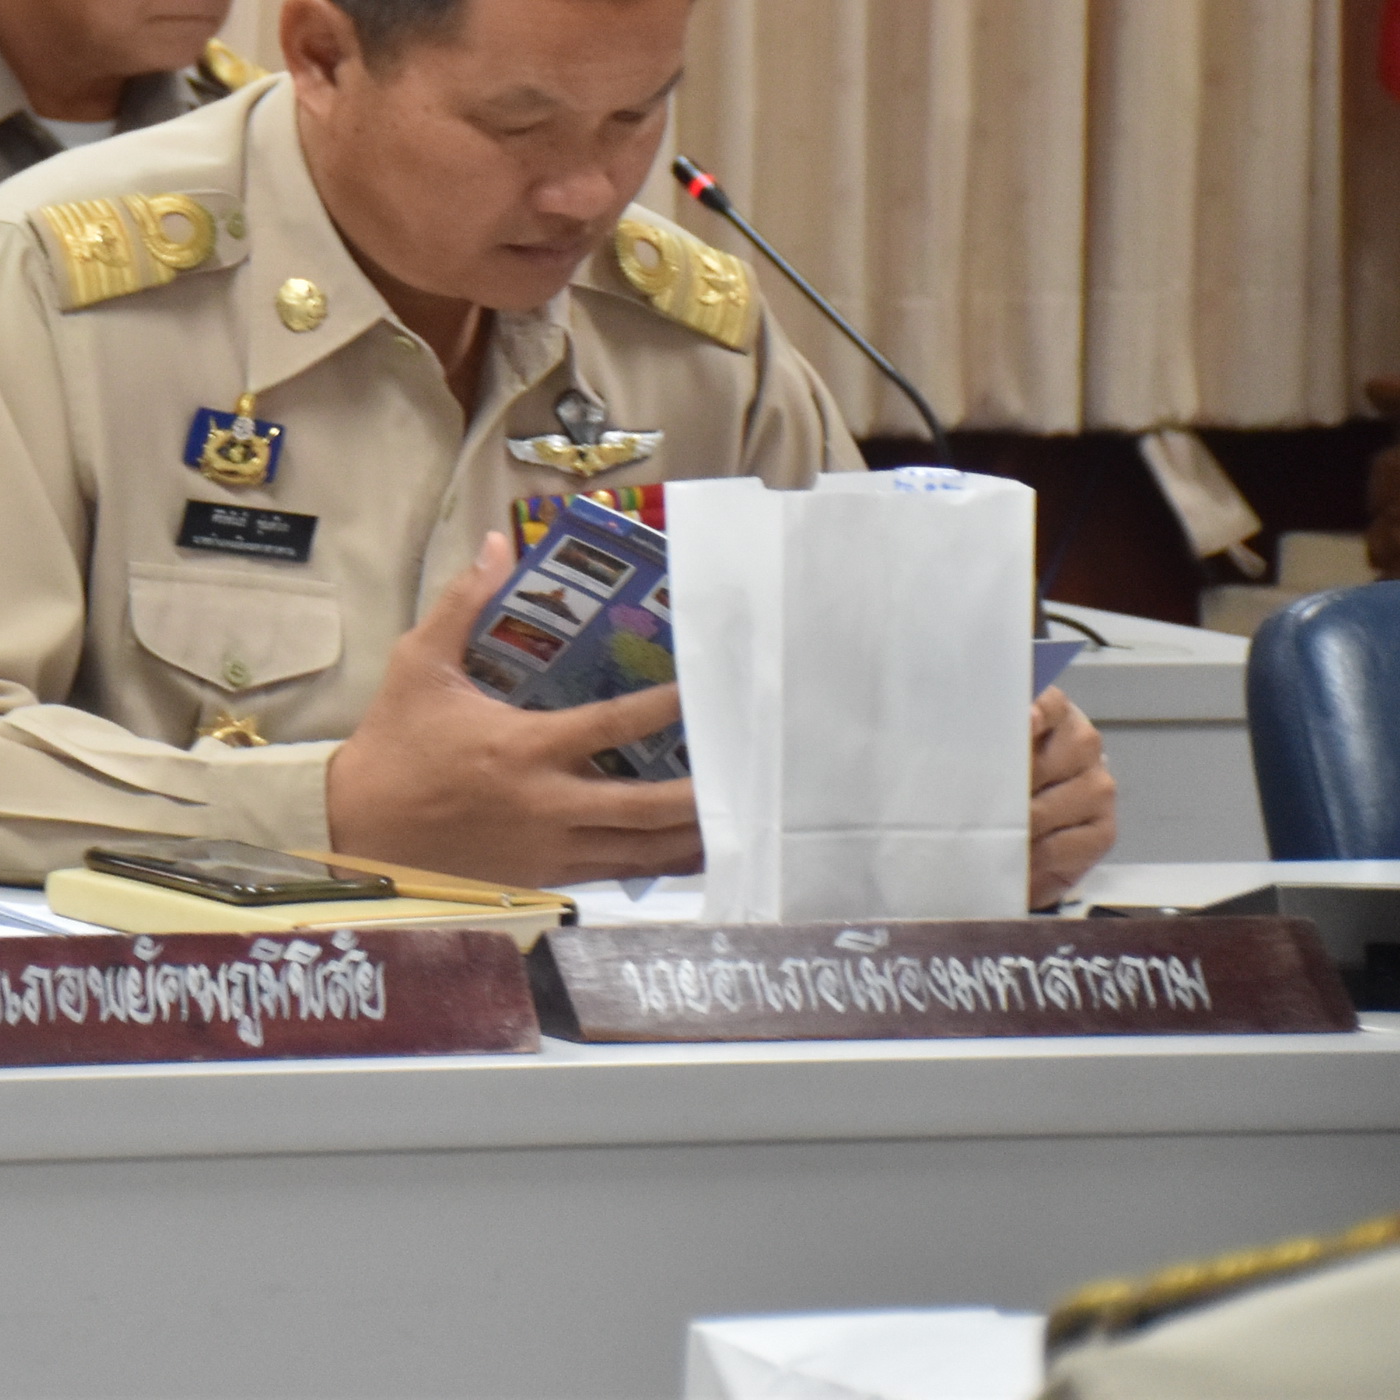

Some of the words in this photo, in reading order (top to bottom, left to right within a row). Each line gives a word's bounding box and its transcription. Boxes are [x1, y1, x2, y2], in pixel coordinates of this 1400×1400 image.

[621, 928, 1212, 1014] นายอำเภอเมืองมหาสารคาม
